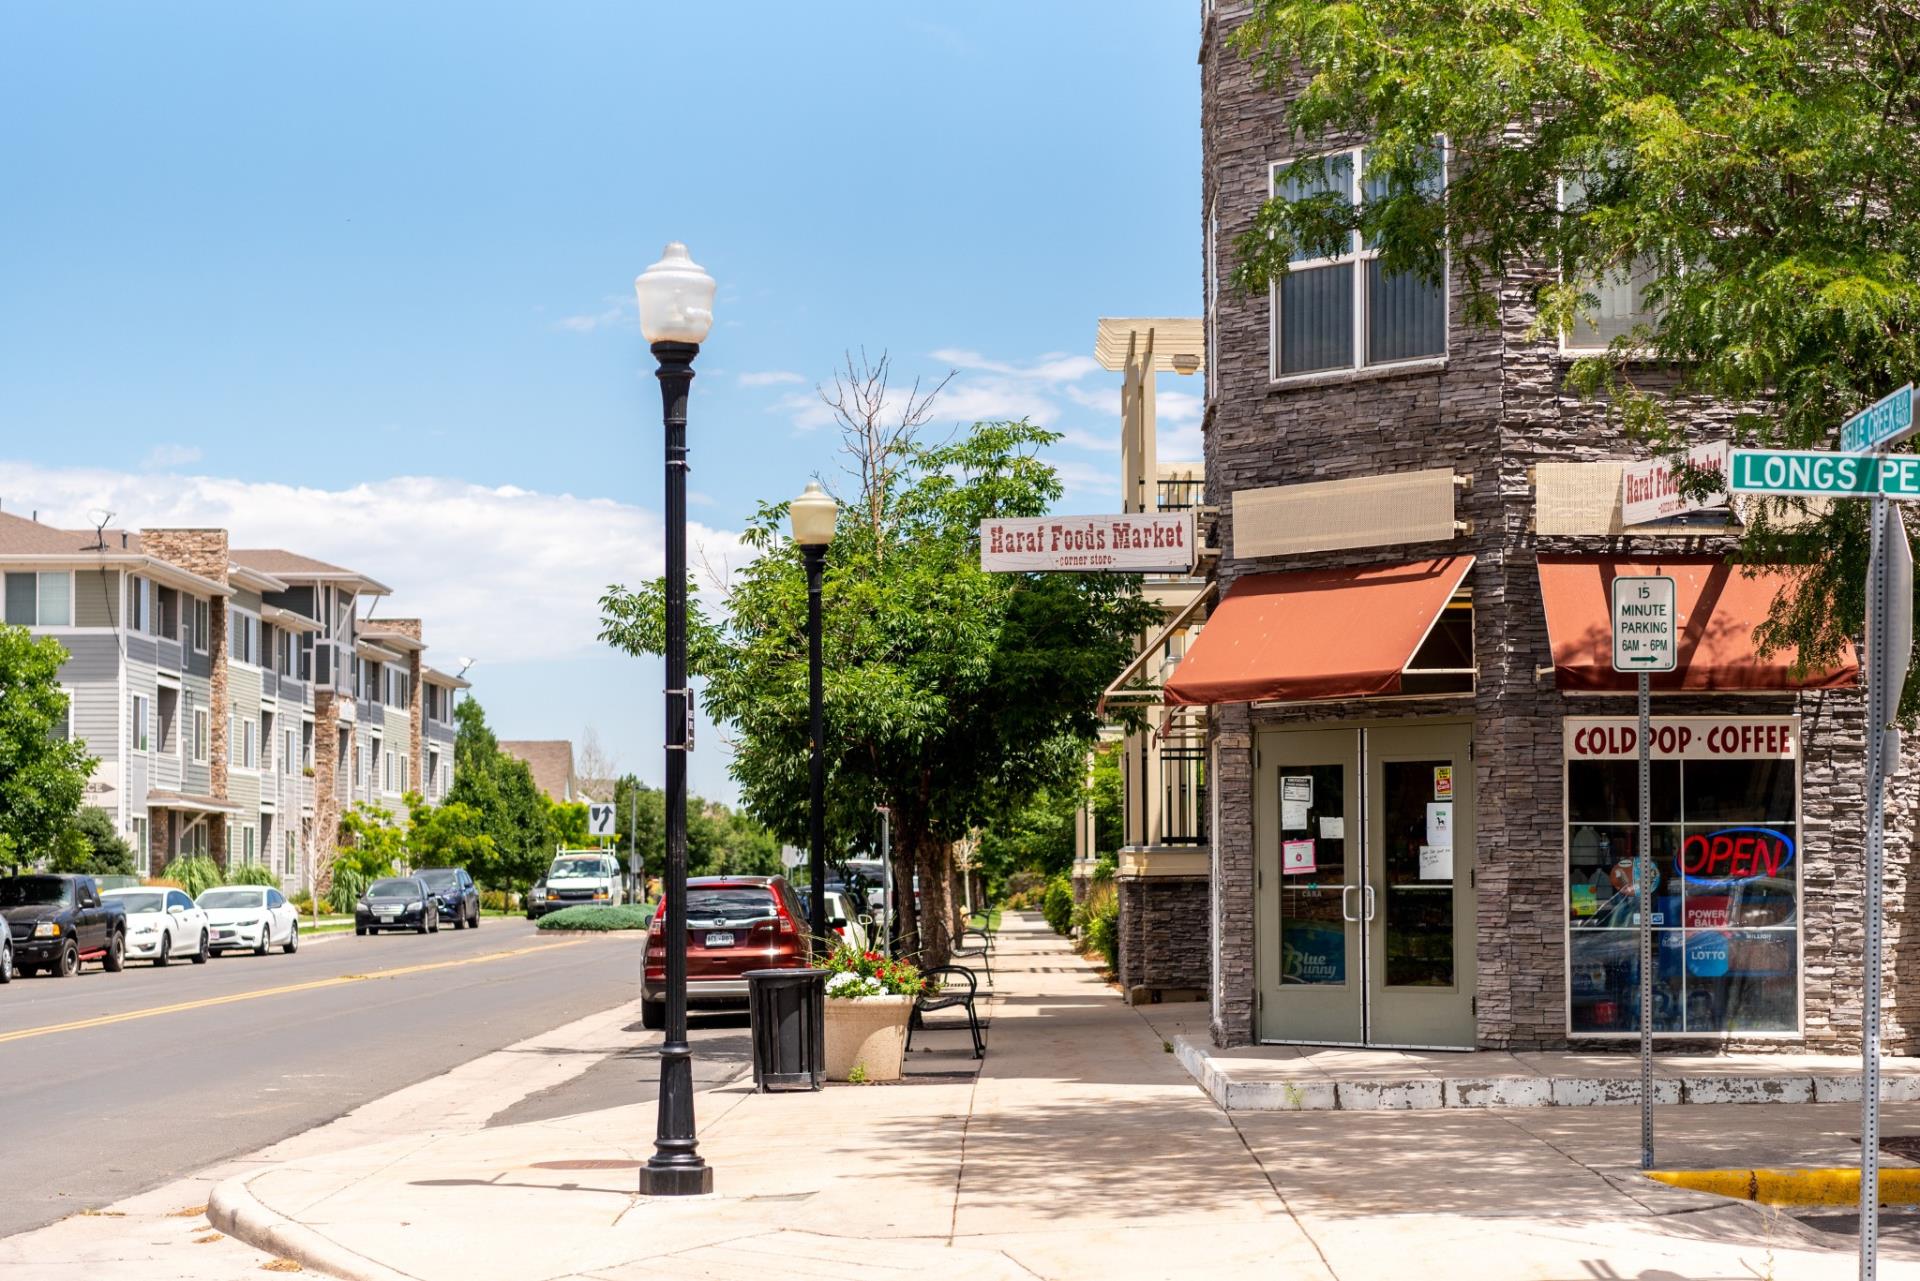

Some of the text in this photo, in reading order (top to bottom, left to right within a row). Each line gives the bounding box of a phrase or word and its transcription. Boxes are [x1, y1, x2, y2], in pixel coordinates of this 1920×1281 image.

[1868, 399, 1896, 444] CREEK
[1744, 456, 1920, 492] LONGS PE
[1626, 467, 1654, 504] Haraf
[1656, 466, 1684, 498] Food
[990, 521, 1183, 553] Haraf Foods Market
[1638, 587, 1650, 599] 15
[1621, 604, 1667, 616] MINUTE
[1621, 622, 1668, 634] PARKING
[1622, 640, 1640, 651] 6AM
[1650, 640, 1667, 651] 6PM
[1574, 726, 1637, 755] COLD
[1707, 725, 1790, 754] COFFEE
[1677, 834, 1783, 878] OPEN
[1688, 909, 1725, 919] POWER
[1691, 951, 1726, 960] LOTTO
